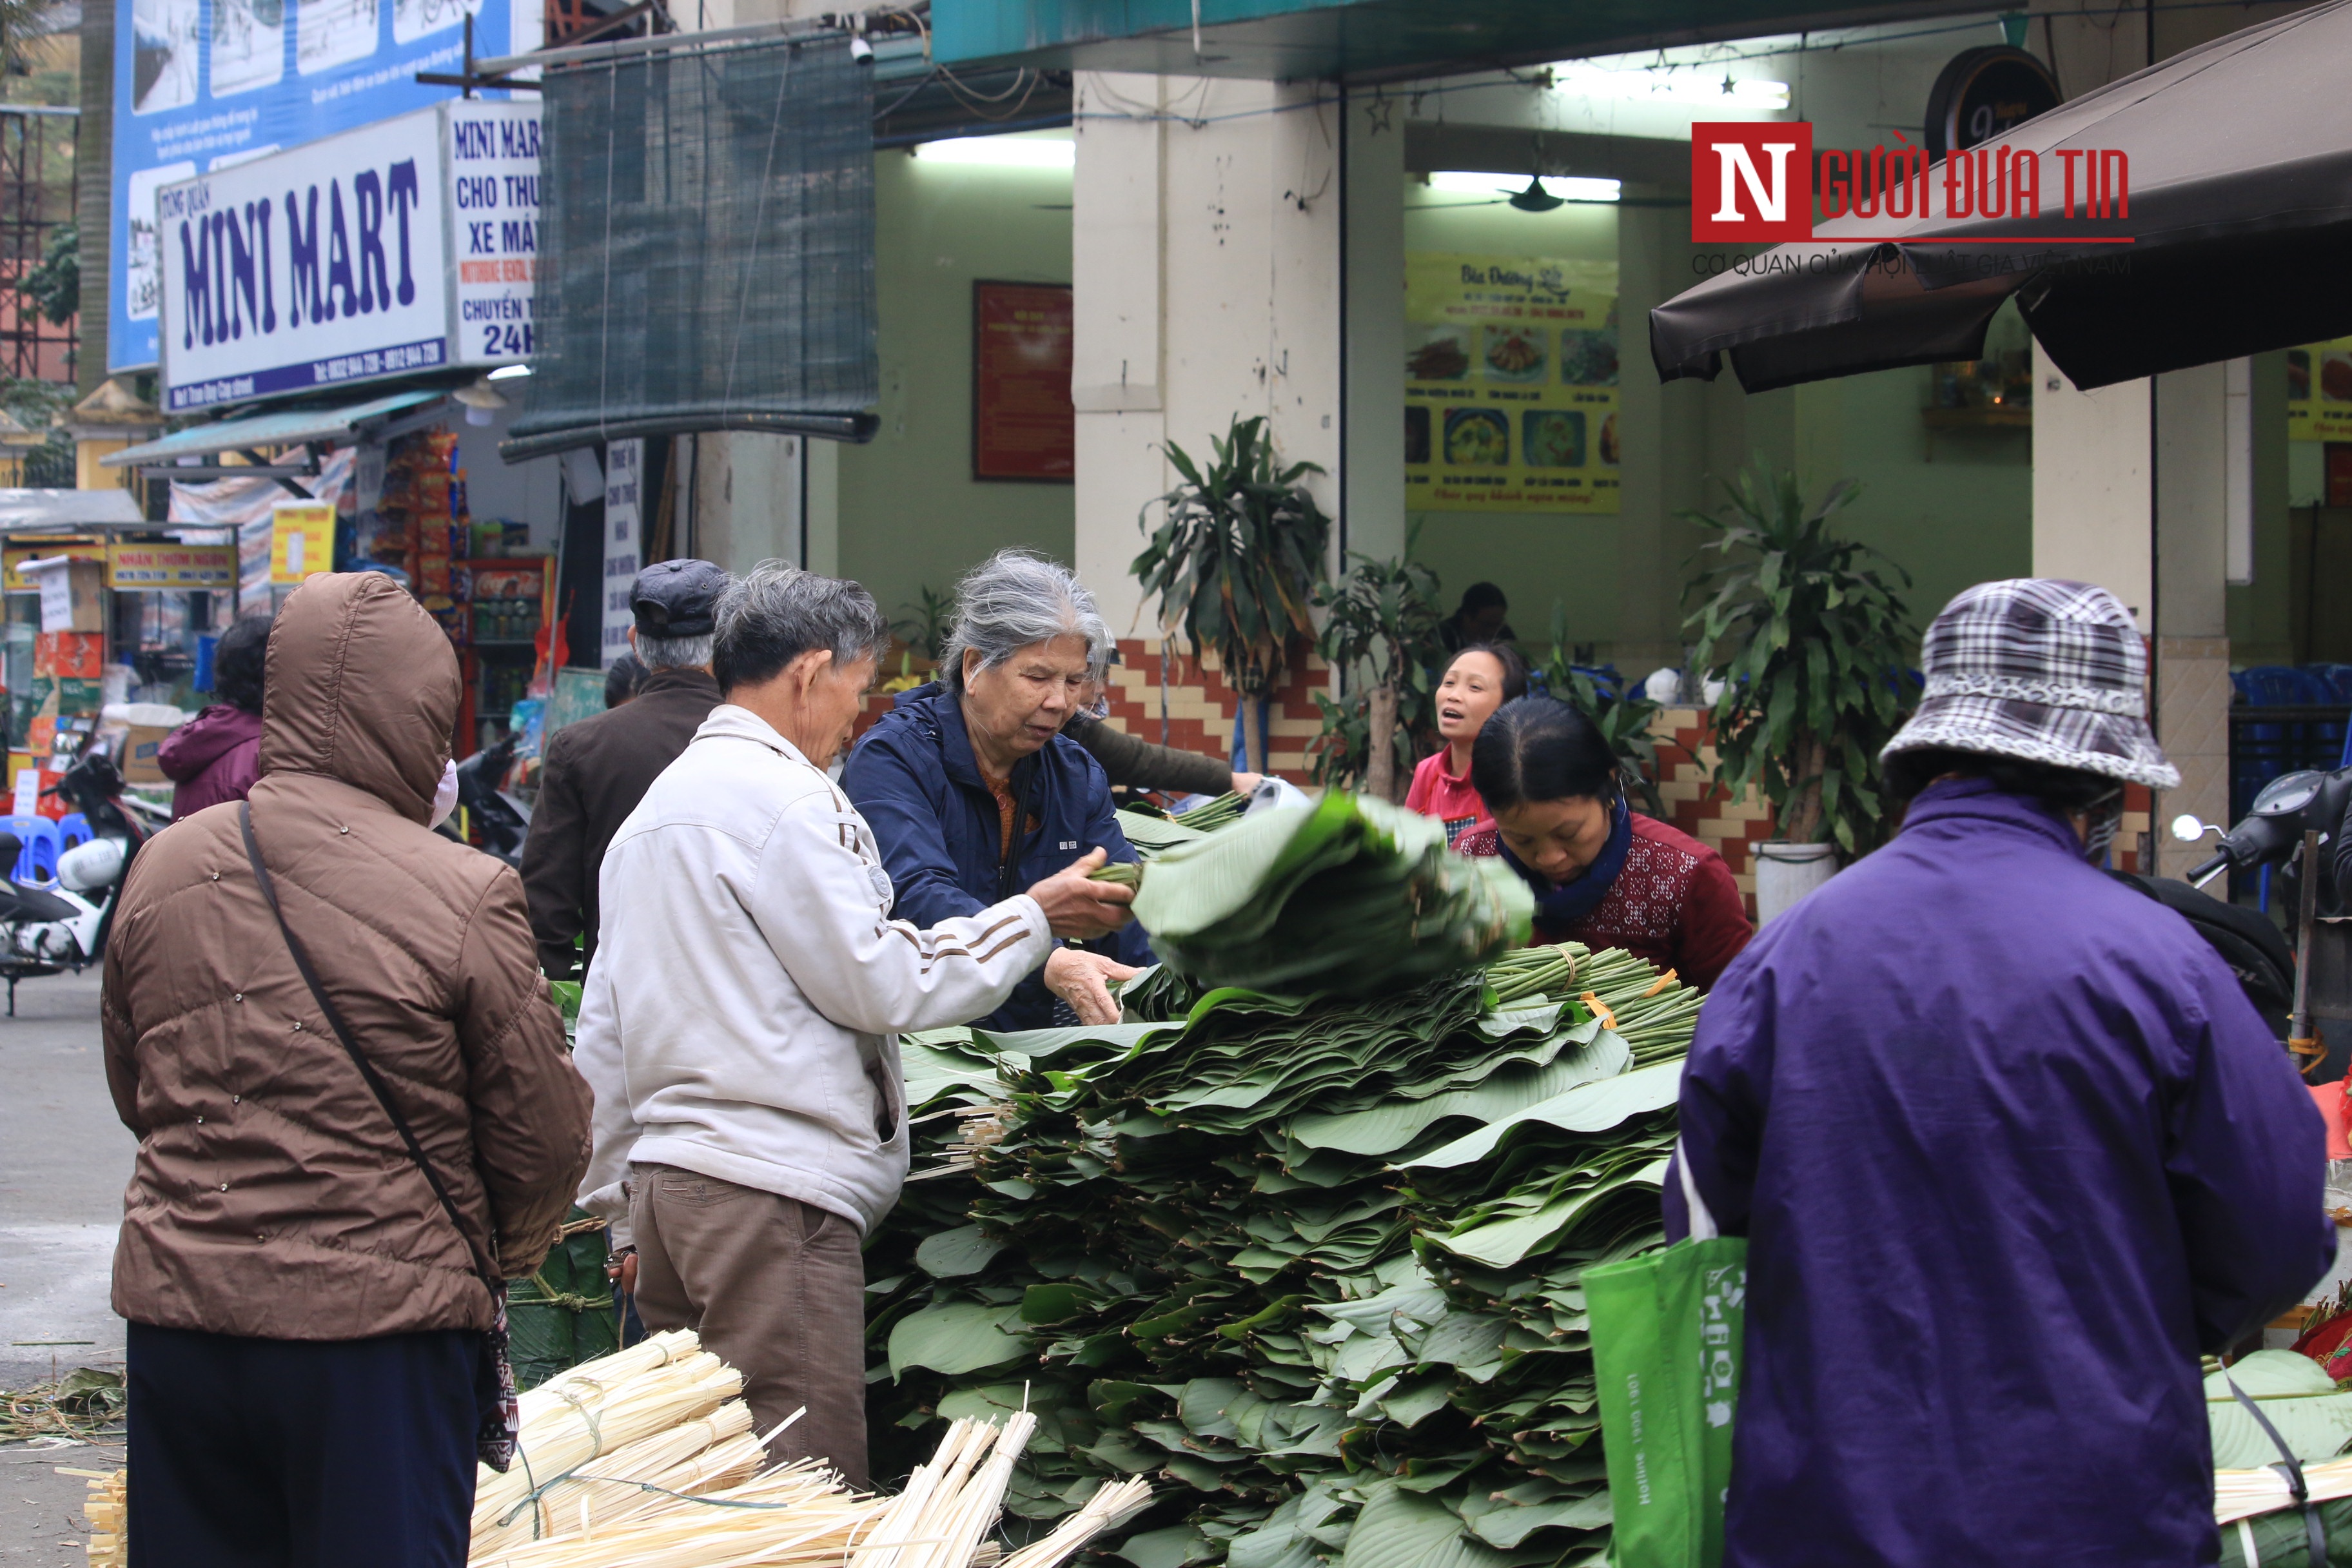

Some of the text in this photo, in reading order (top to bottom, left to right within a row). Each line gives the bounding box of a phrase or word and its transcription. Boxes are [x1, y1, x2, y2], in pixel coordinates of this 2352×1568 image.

[455, 119, 544, 159] MINI MAR
[457, 175, 547, 208] CHO THU
[180, 157, 418, 350] MINI MART
[469, 221, 495, 253] XE
